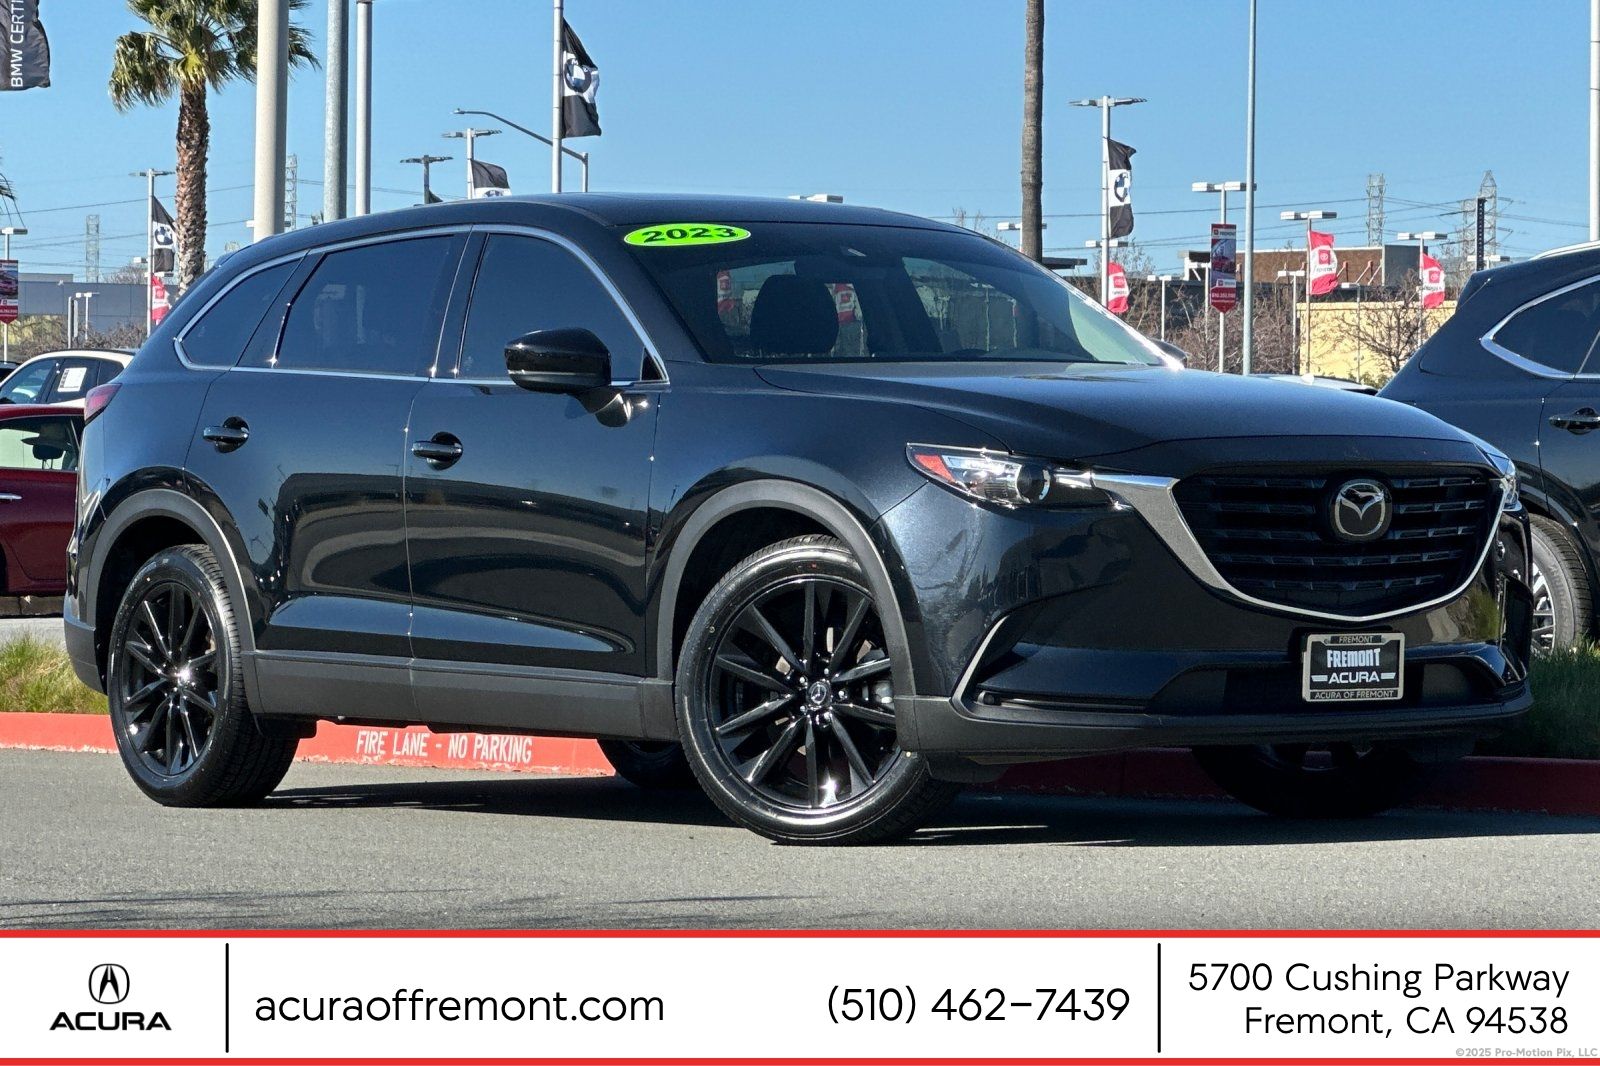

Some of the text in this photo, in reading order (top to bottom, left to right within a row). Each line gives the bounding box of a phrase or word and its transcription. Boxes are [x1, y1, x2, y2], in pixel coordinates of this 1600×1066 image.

[10, 48, 24, 87] BMW
[641, 227, 737, 243] 2023
[1326, 648, 1381, 668] FREMONT
[1328, 671, 1380, 684] ACURA
[1314, 690, 1395, 699] ACURA OF FREMONT
[355, 730, 389, 756] FIRE
[392, 732, 431, 757] LANE
[447, 733, 468, 759] NO
[472, 734, 533, 763] PARKING
